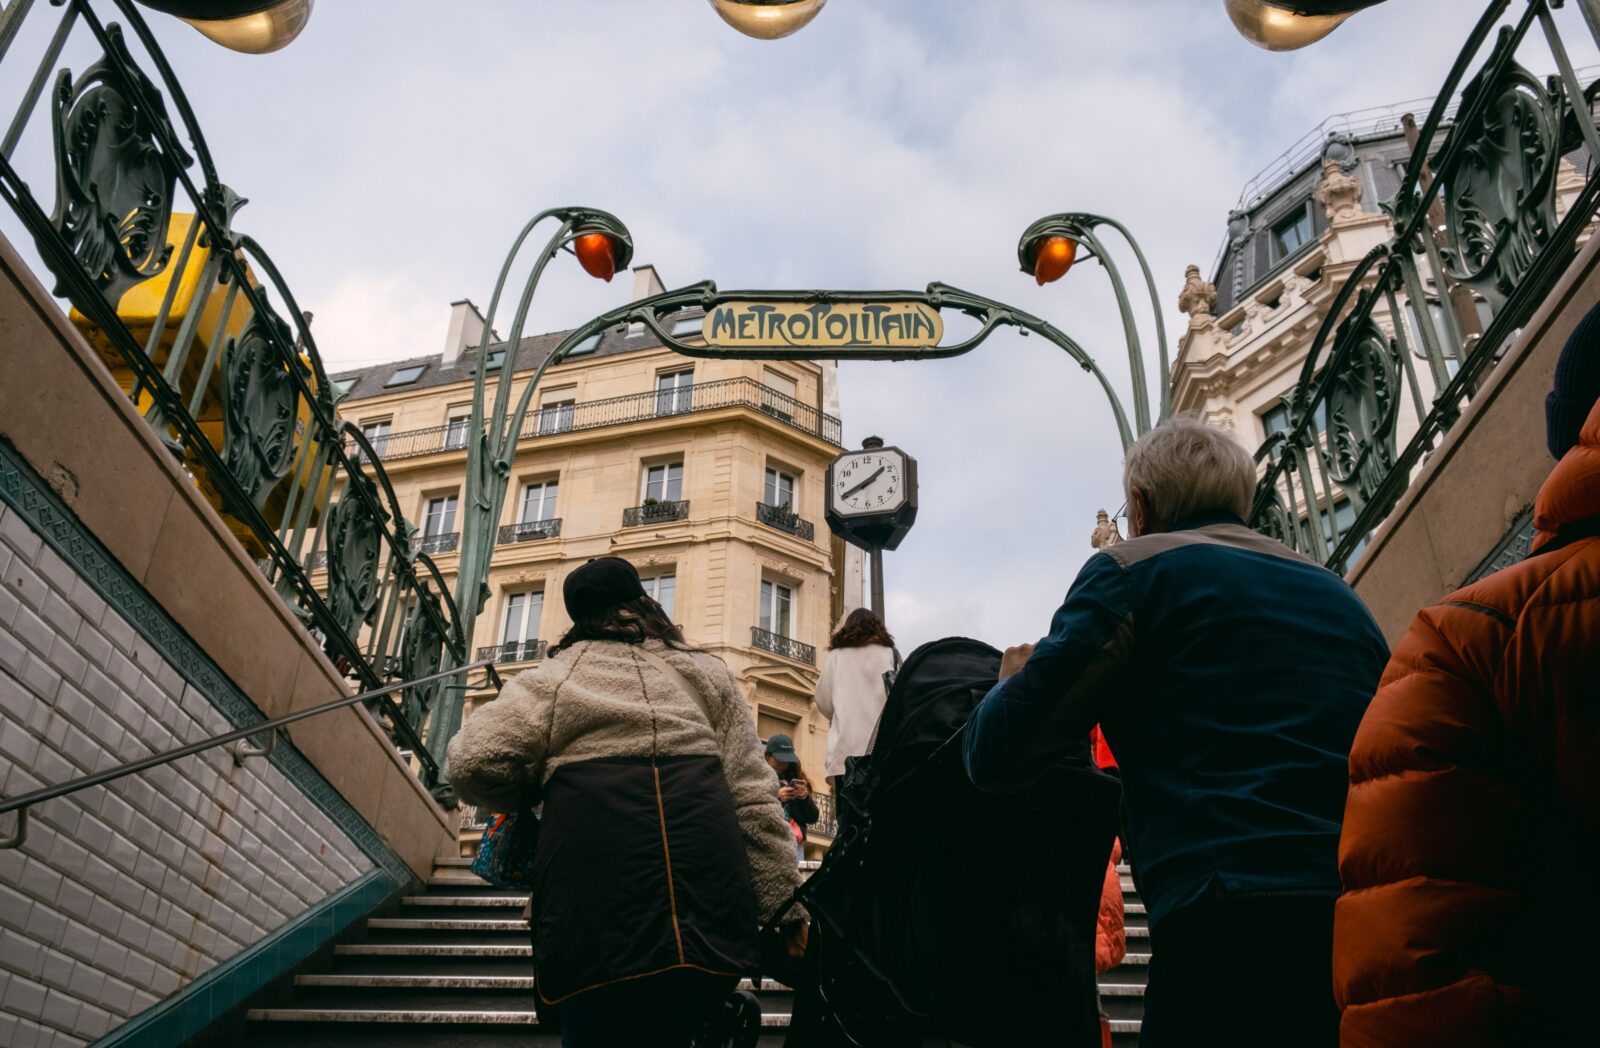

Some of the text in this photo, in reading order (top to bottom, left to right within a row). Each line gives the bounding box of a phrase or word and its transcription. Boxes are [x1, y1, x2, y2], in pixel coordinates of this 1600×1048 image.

[711, 303, 936, 346] METROPOLITAIN
[852, 460, 858, 469] 11
[863, 456, 872, 465] 12
[842, 470, 851, 478] 10
